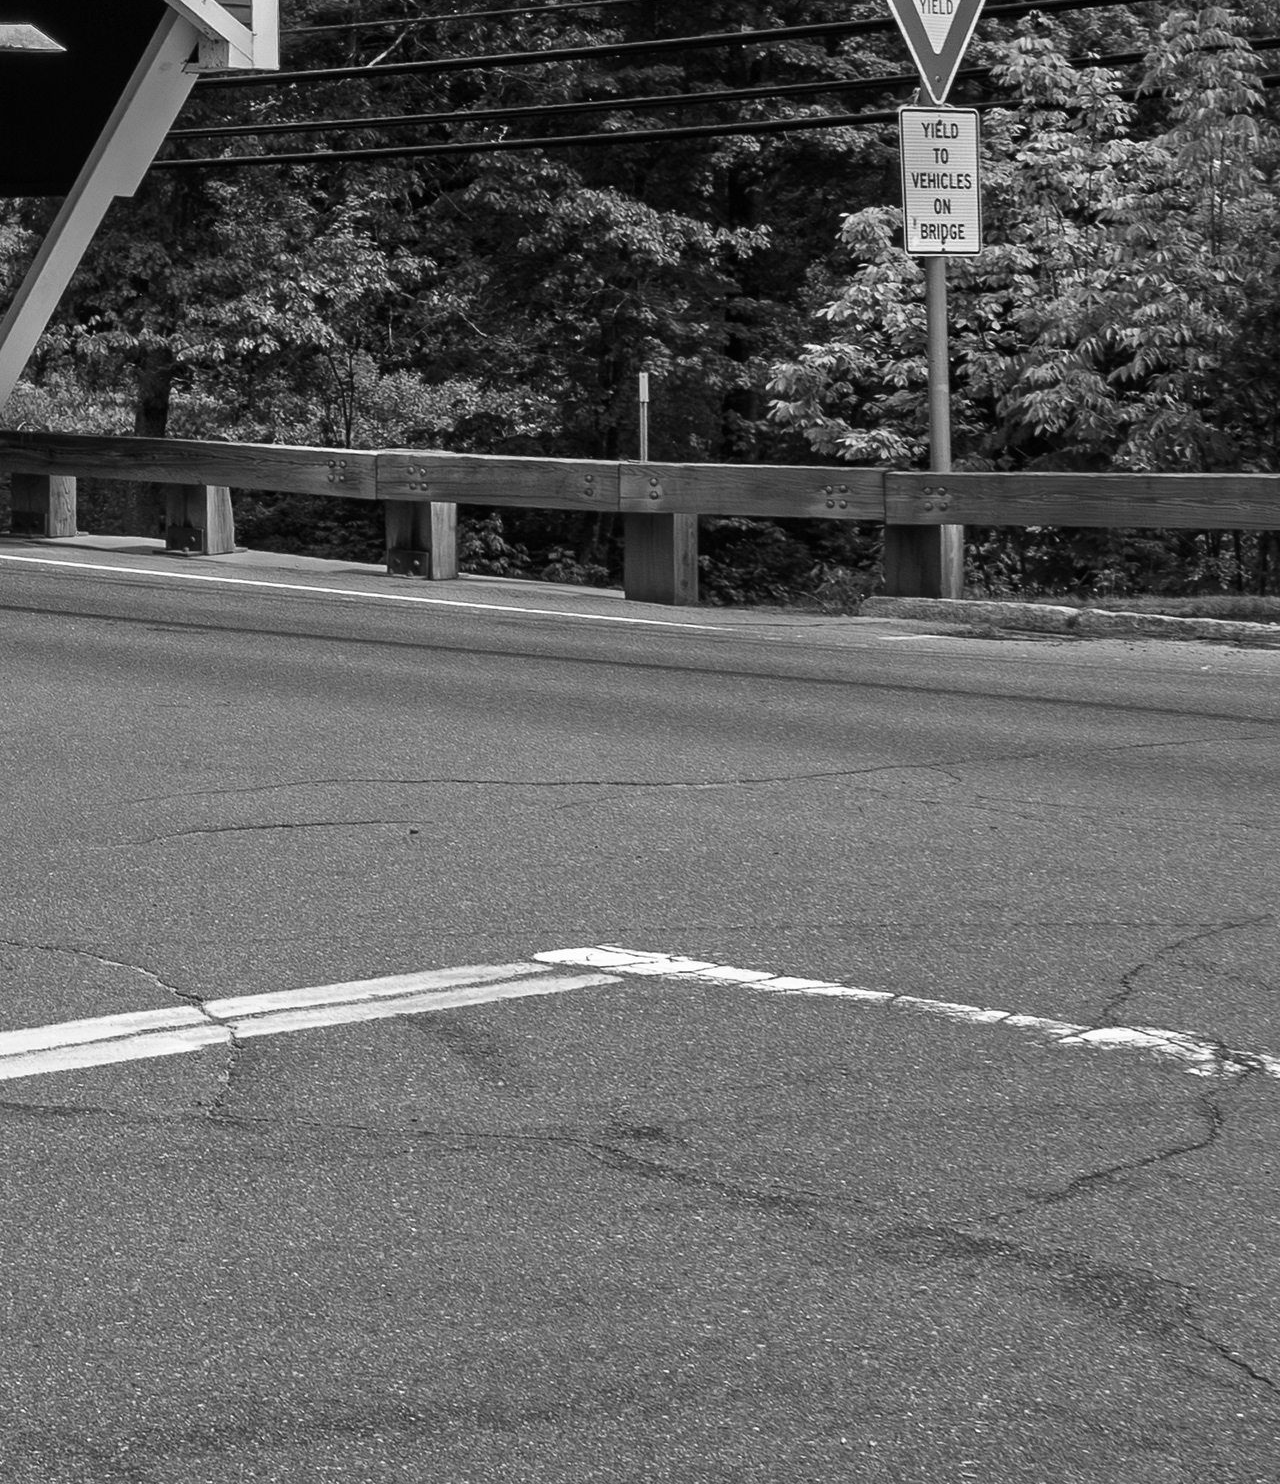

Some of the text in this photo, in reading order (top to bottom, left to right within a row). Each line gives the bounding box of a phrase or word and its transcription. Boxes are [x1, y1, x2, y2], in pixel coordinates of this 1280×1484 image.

[920, 121, 959, 139] YIELD
[932, 147, 949, 165] TO
[910, 172, 972, 190] VEHICLES
[933, 197, 952, 215] ON
[919, 222, 966, 240] BRIDGE
